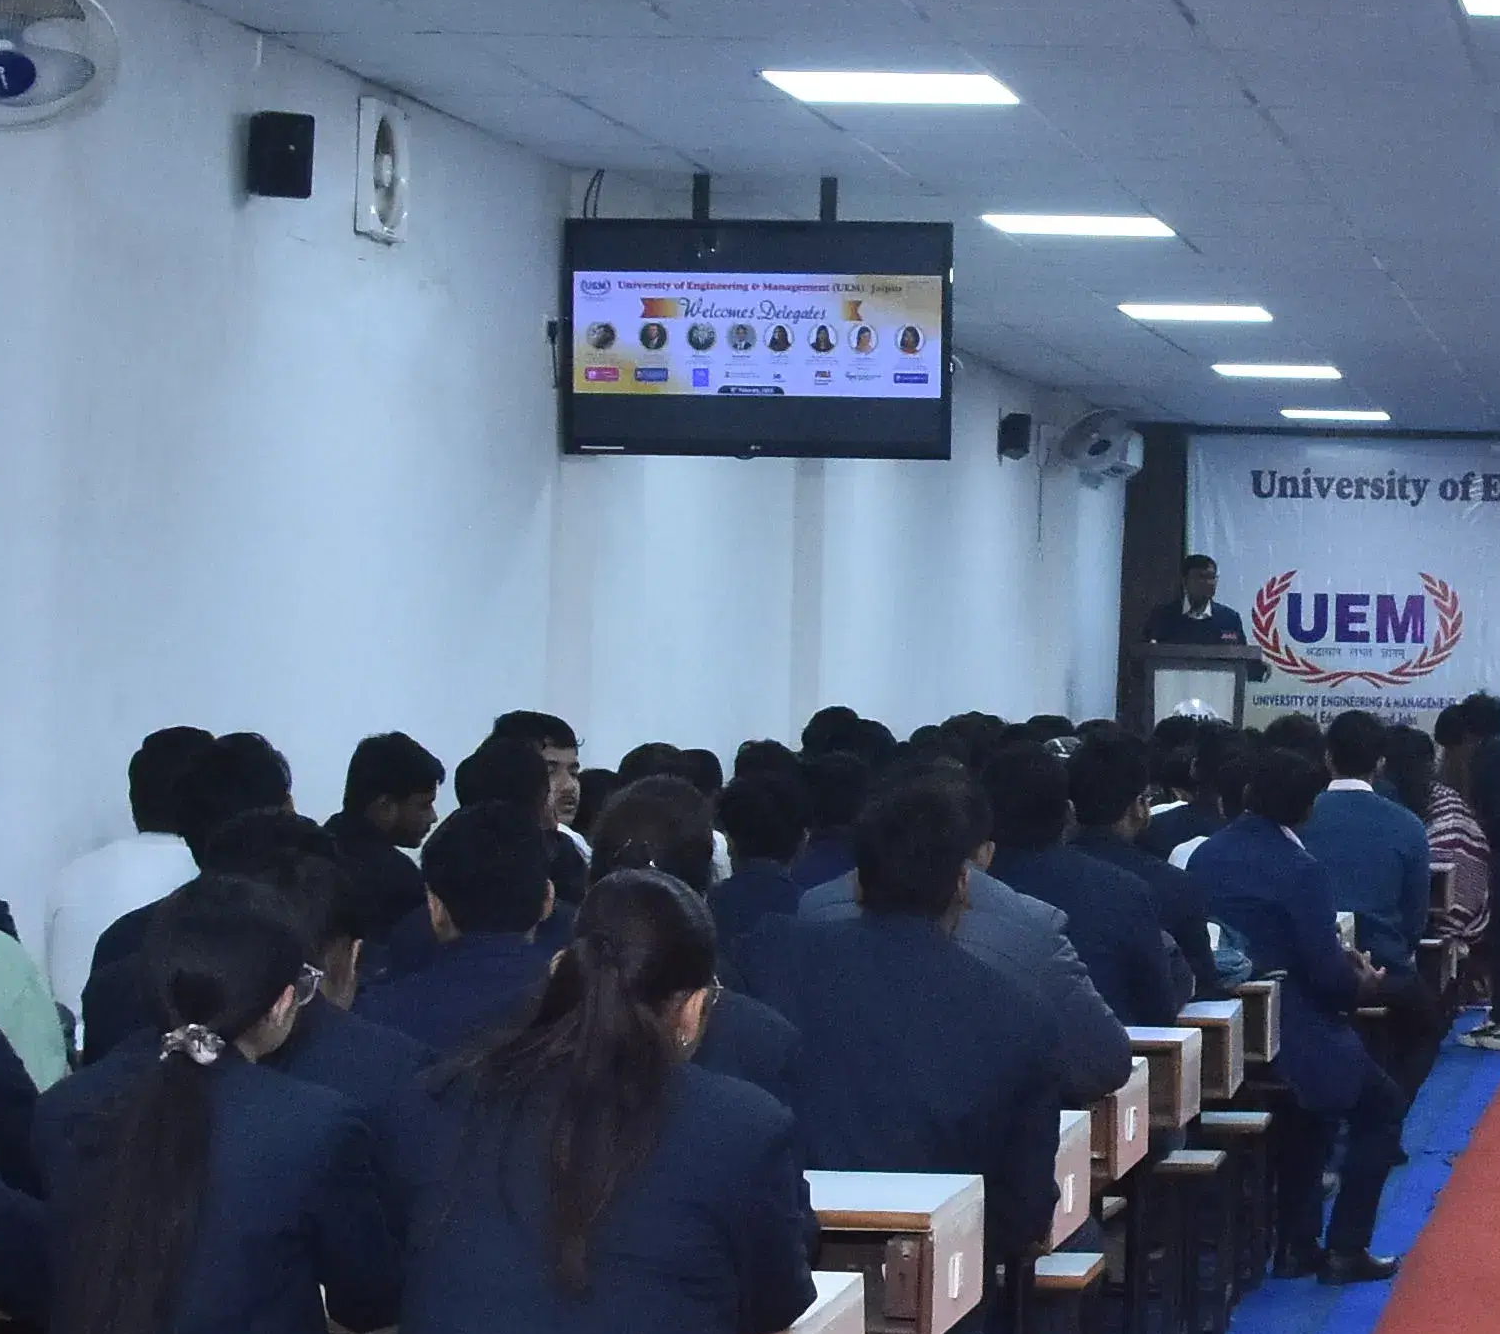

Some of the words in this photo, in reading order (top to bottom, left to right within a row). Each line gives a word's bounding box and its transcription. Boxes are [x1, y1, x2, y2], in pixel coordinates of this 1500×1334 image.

[679, 297, 756, 319] Welcomes
[756, 299, 827, 323] Delegates
[1250, 468, 1428, 507] University
[1438, 472, 1481, 502] of
[1287, 593, 1425, 644] UEM
[1252, 694, 1305, 708] UNIVERSITY
[1306, 695, 1319, 708] OF
[1320, 695, 1383, 709] ENGINEERING
